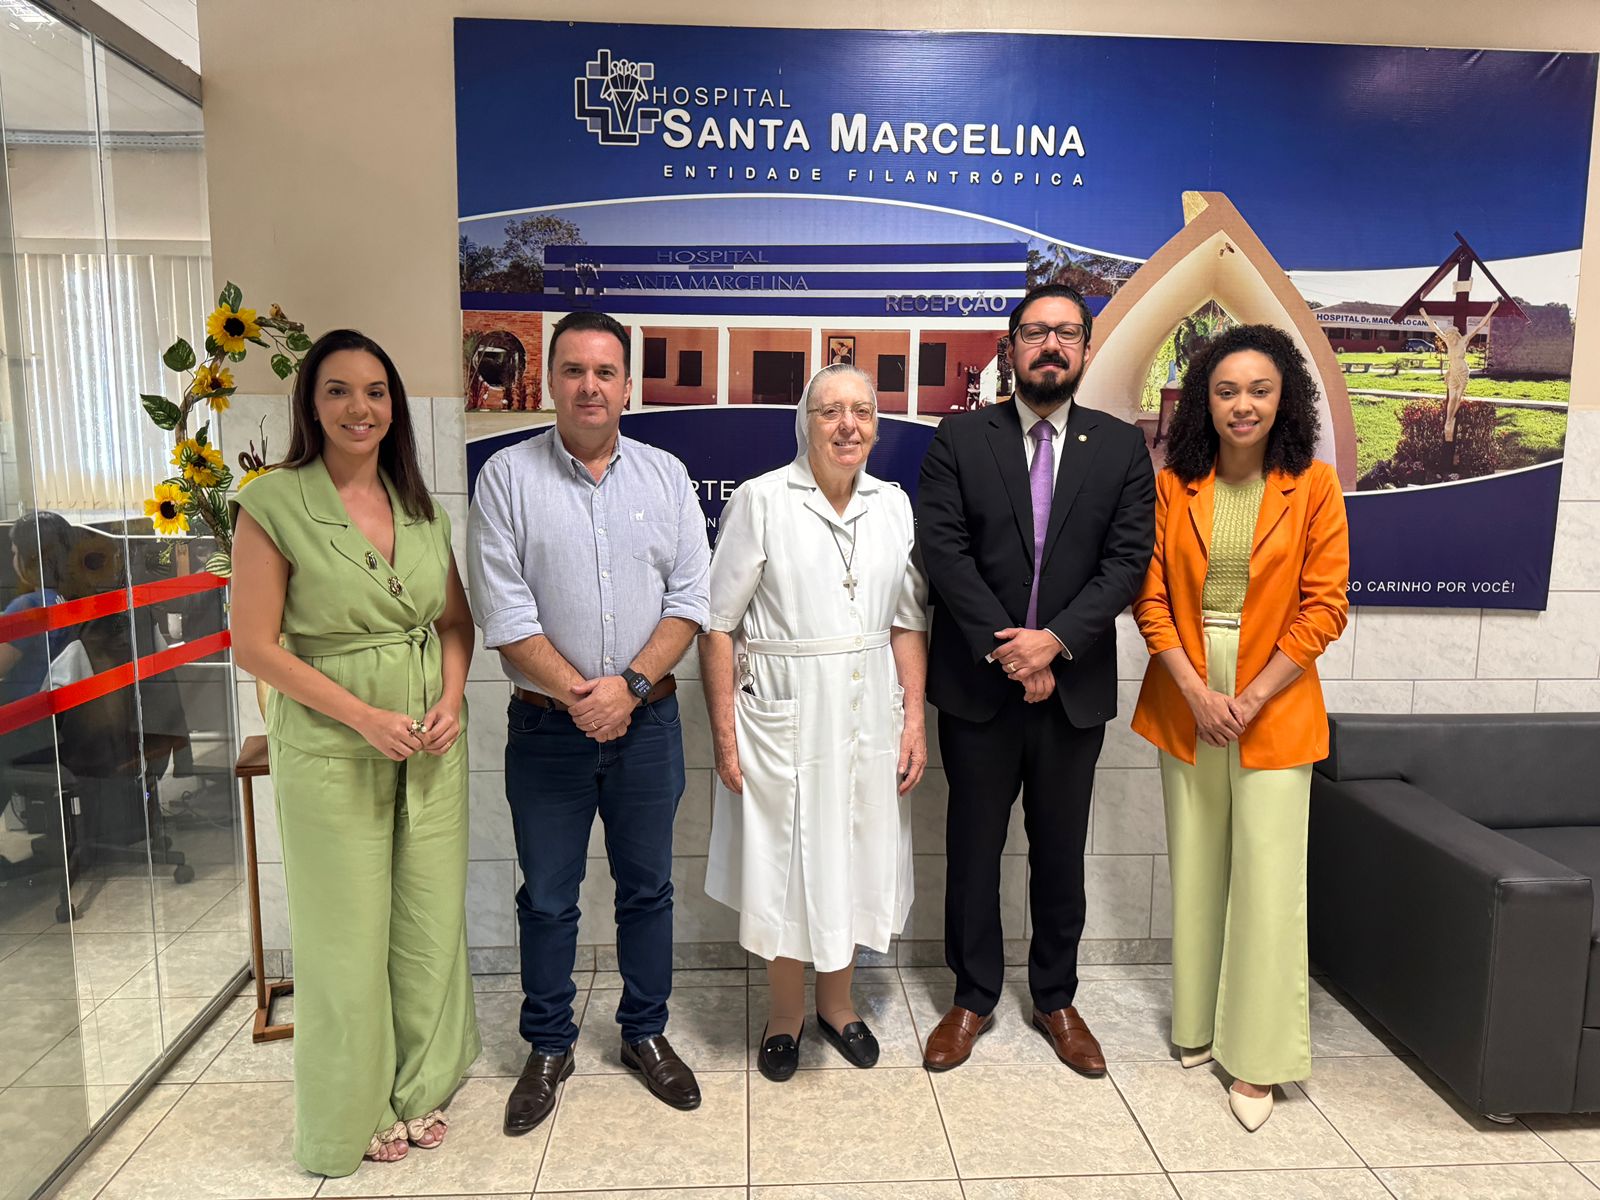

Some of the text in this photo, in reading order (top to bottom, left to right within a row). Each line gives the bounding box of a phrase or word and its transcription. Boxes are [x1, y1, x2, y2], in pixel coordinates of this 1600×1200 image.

[653, 86, 791, 108] HOSPITAL
[662, 108, 1086, 157] SANTA MARCELINA
[663, 164, 1084, 187] ENTIDADE FILANTRÓPICA
[656, 250, 769, 264] HOSPITAL
[619, 274, 809, 292] SANTA MARCELINA
[885, 291, 1007, 316] RECEPÇÃO
[1316, 313, 1359, 323] HOSPITAL
[1367, 581, 1432, 593] CARINHO
[1436, 581, 1466, 593] POR
[1471, 580, 1515, 593] VOCÊ!
